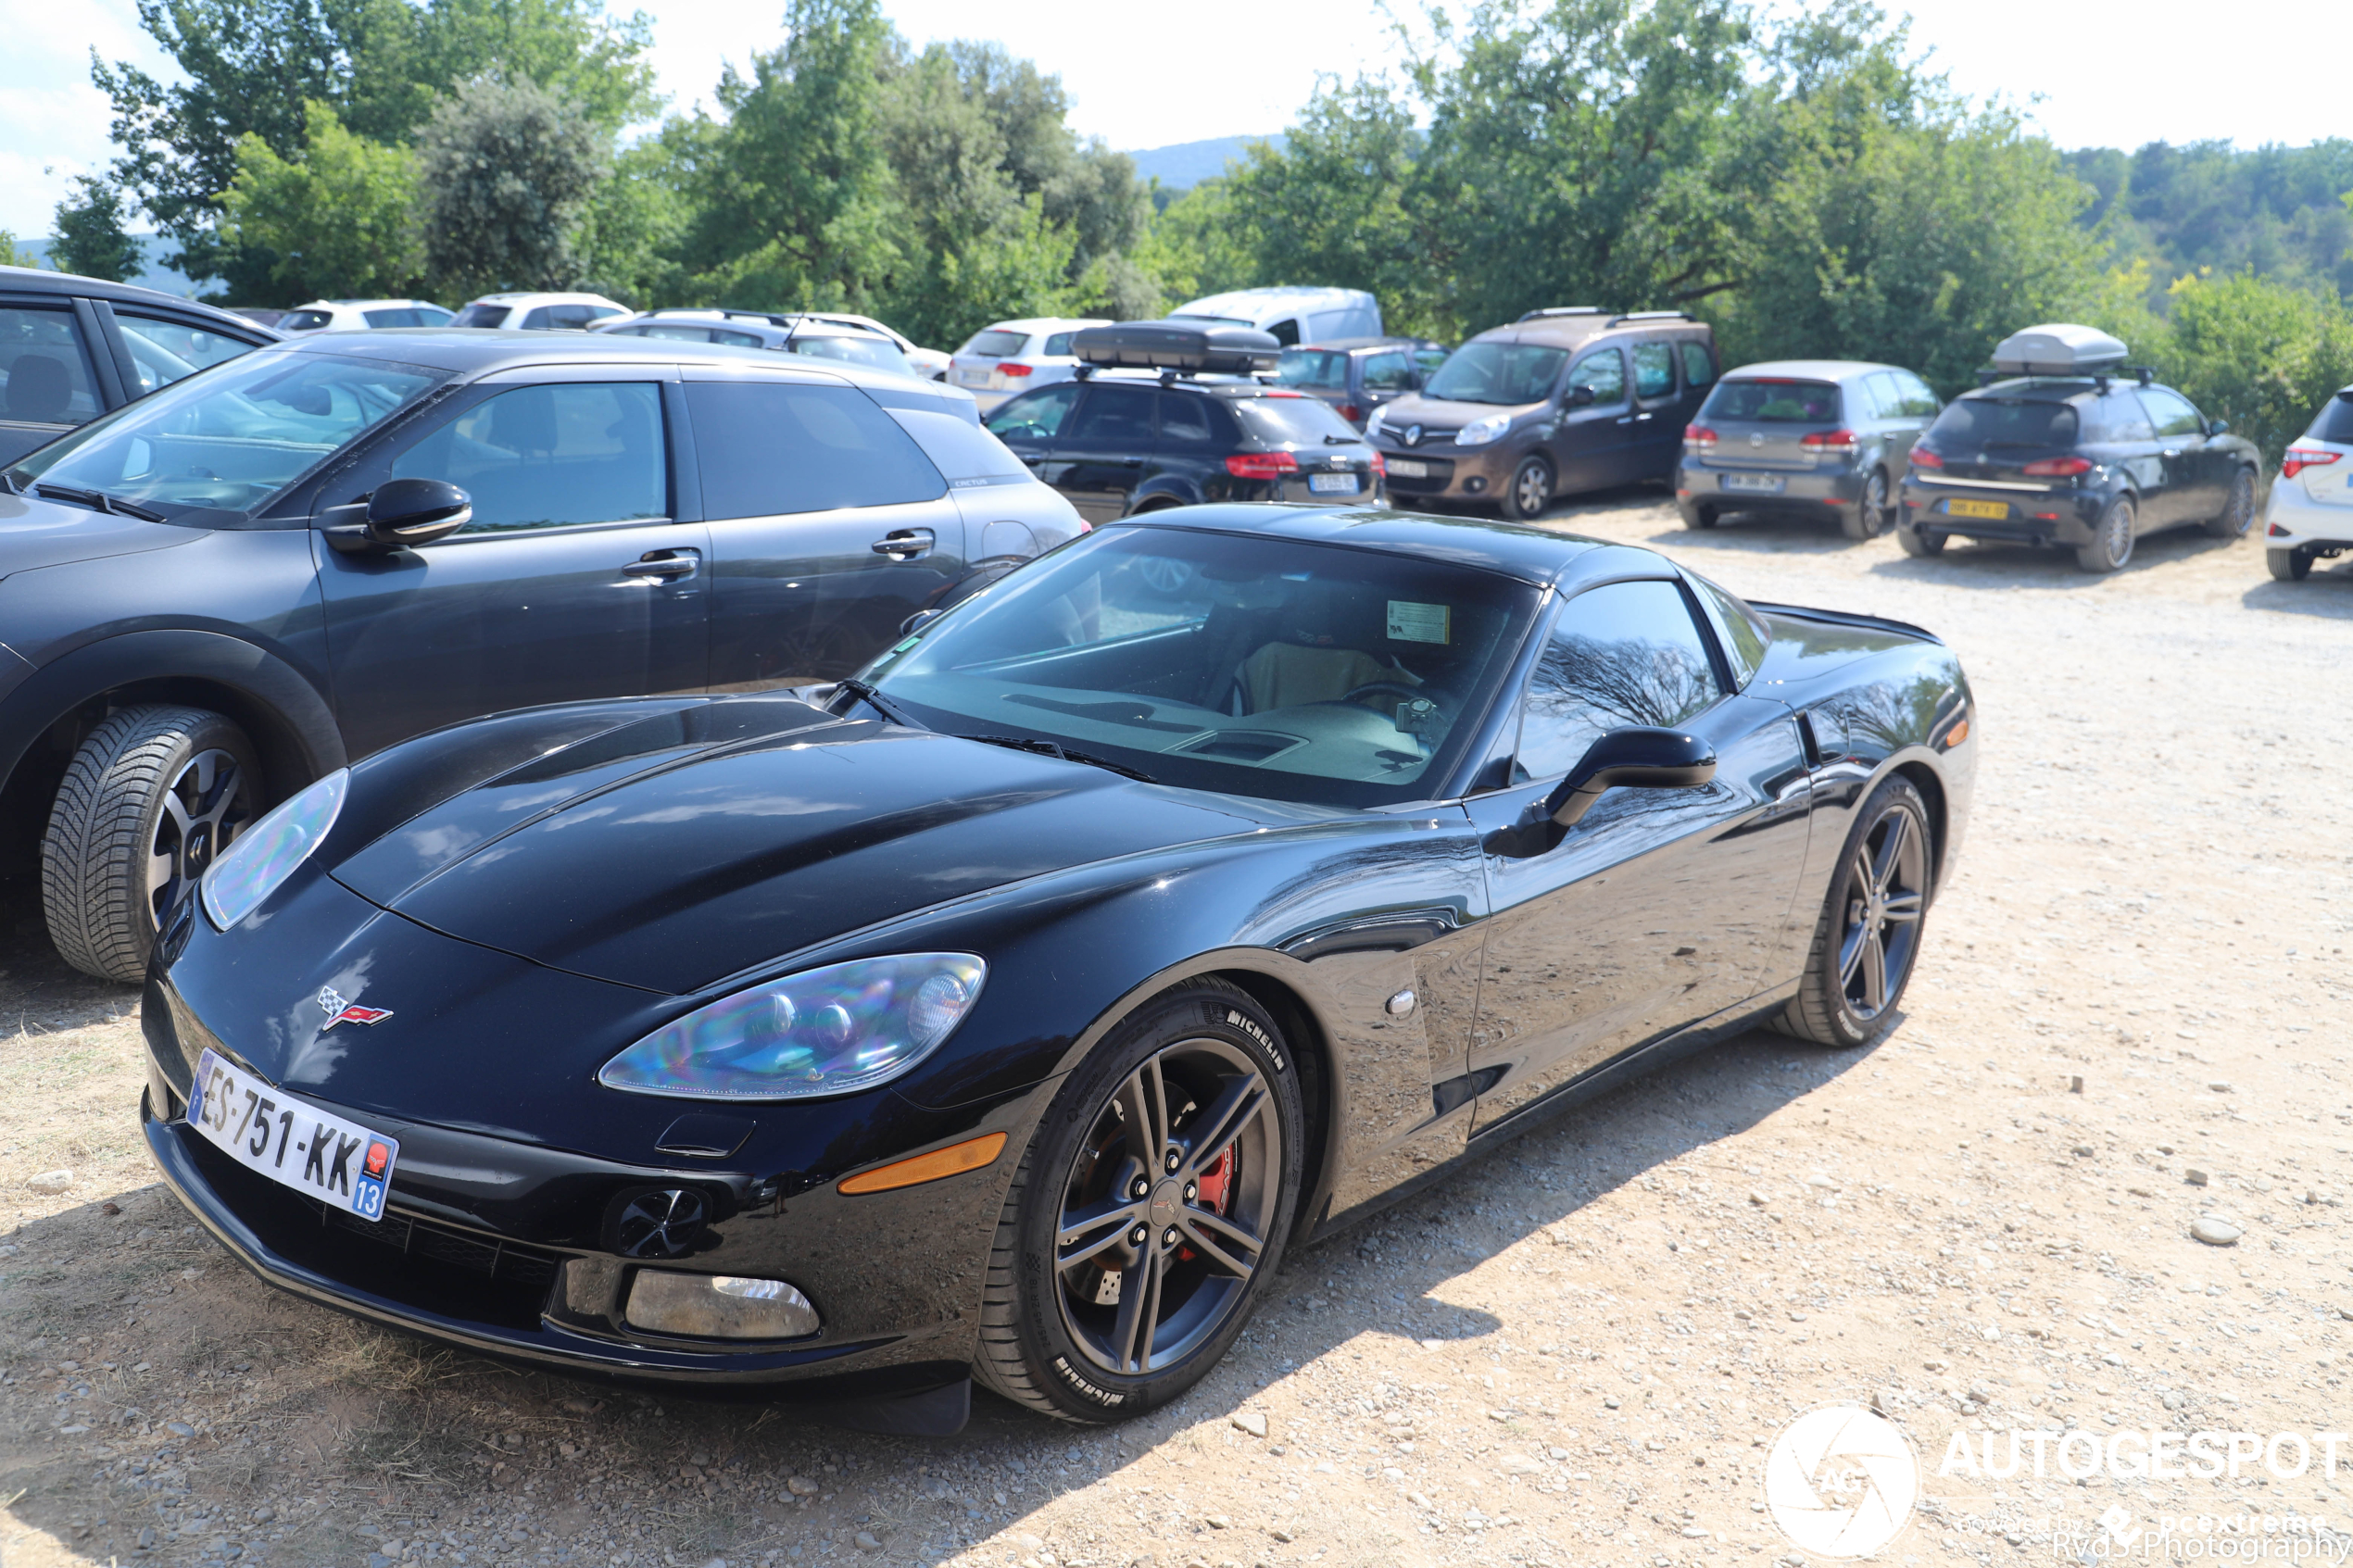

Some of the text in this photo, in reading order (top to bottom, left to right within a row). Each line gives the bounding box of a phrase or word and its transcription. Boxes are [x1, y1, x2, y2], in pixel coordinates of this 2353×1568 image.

[954, 478, 988, 487] CACTUS
[1227, 1010, 1285, 1071] MICHELIN
[1287, 1079, 1298, 1110] PILOT
[193, 1066, 361, 1198] F ES-751-KK
[358, 1181, 381, 1214] 13
[1029, 1279, 1038, 1290] 18
[1031, 1294, 1039, 1310] ZR
[1052, 1356, 1125, 1408] MICHELIN
